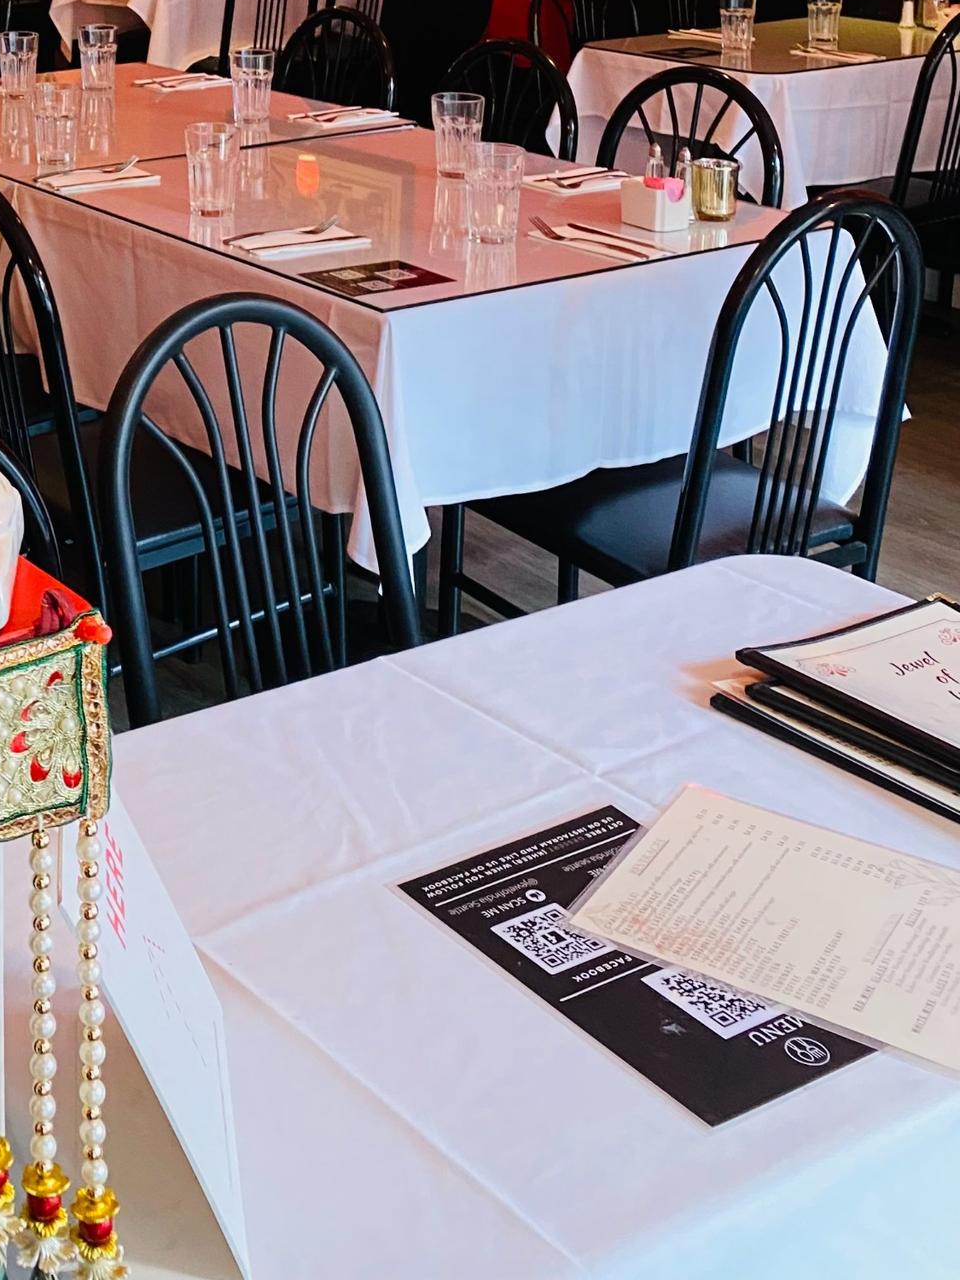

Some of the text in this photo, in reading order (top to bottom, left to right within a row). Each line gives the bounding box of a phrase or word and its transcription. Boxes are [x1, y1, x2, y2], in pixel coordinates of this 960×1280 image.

[889, 651, 941, 676] Jewel
[936, 668, 960, 684] of
[585, 827, 607, 838] FREE
[608, 820, 624, 830] GET
[421, 816, 614, 892] US ON INSTAGRAM AND LIKE US ON FACEBOOK
[485, 863, 512, 876] WHEN
[465, 874, 484, 884] YOU
[426, 882, 464, 899] FOLLOW
[481, 897, 527, 918] SCAN ME
[571, 955, 632, 983] FACEBOOK
